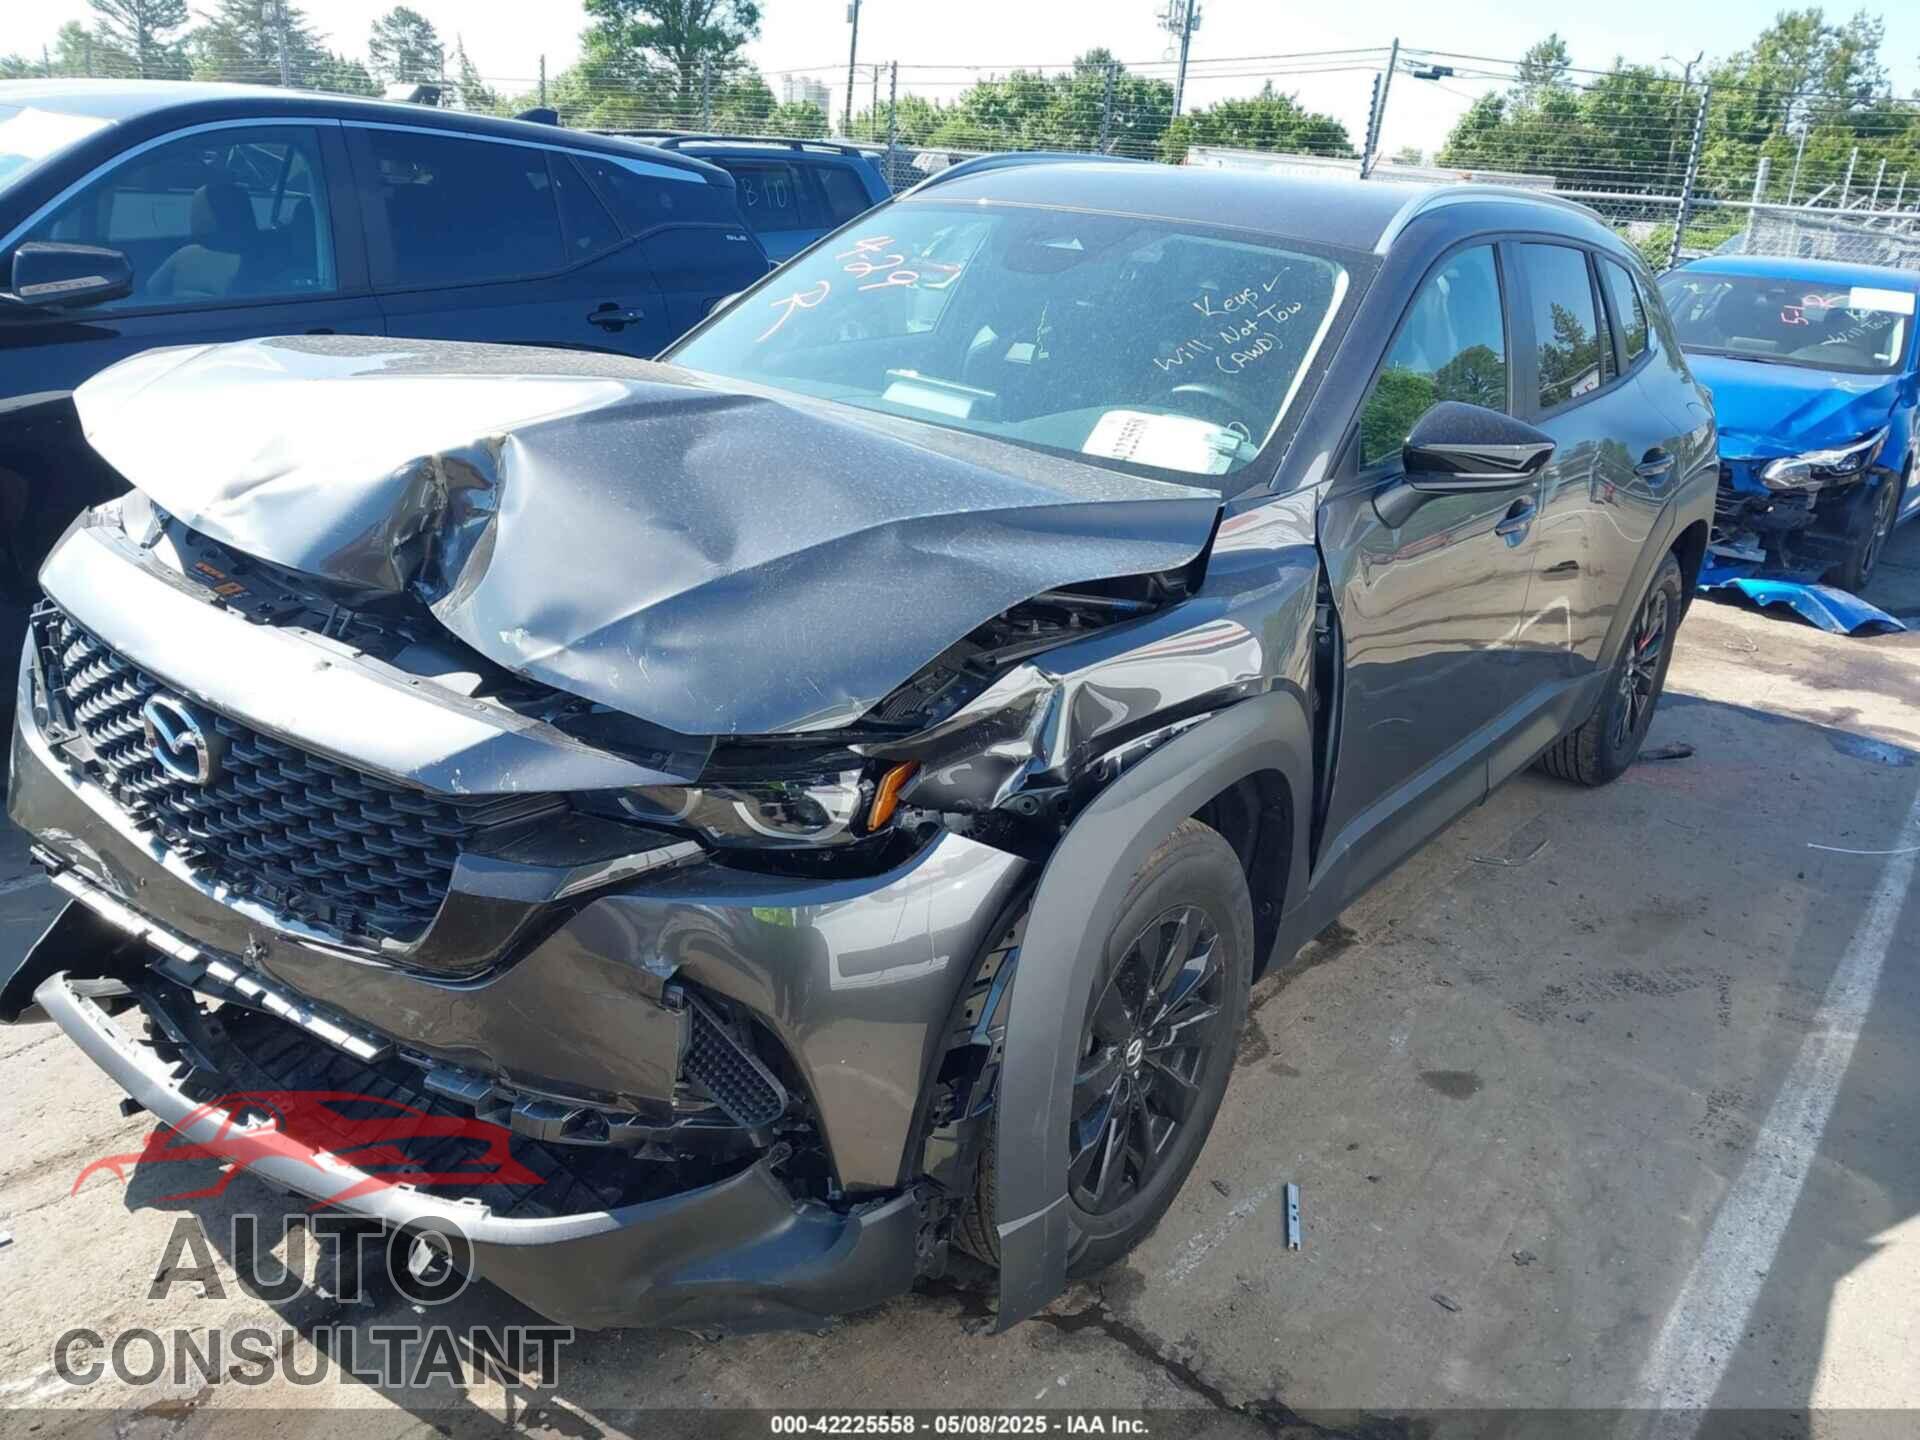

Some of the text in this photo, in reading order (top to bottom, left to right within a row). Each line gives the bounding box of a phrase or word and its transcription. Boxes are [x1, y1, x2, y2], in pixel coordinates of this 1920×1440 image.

[1153, 302, 1302, 370] Will Not Tow
[1216, 332, 1284, 374] (AWD)
